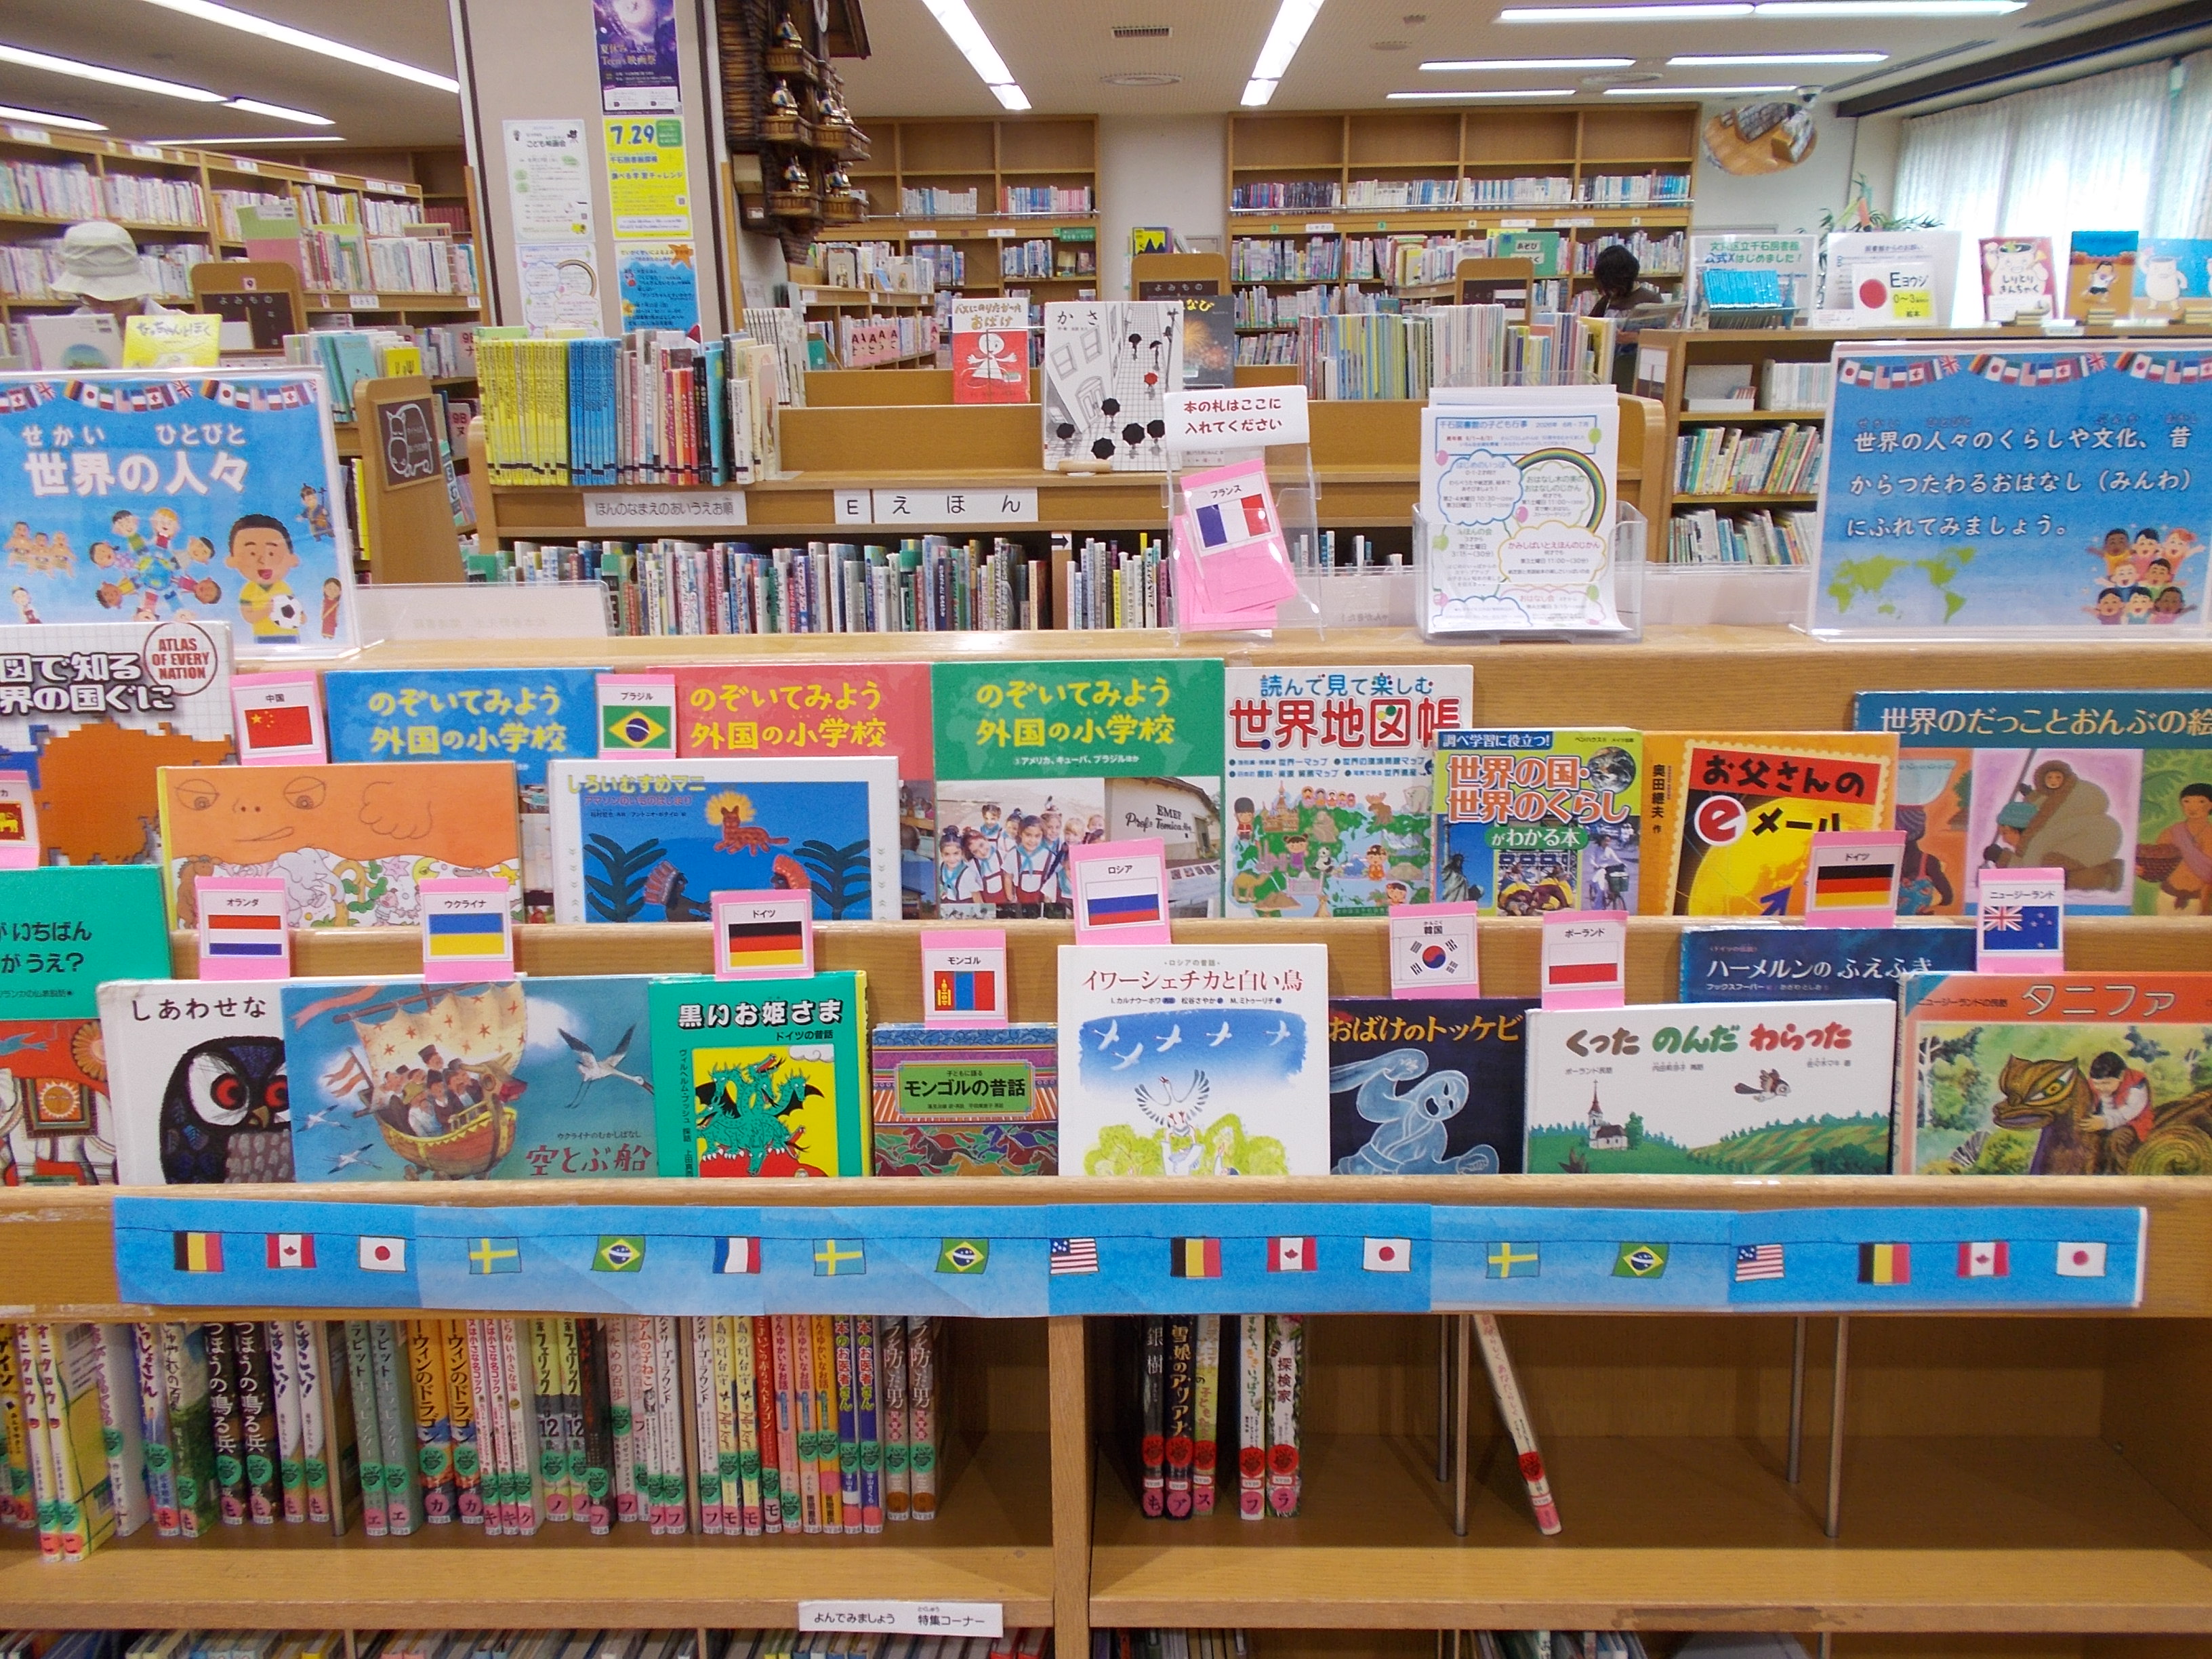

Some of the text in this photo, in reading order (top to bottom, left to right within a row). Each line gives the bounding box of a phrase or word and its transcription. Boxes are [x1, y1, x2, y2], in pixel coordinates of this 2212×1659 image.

[610, 125, 655, 144] 7.29
[1517, 242, 1538, 251] あそび
[1155, 283, 1203, 291] よみもの
[219, 295, 273, 306] よみもの
[971, 314, 1013, 331] おばけ
[1057, 310, 1098, 325] かさ
[1183, 398, 1282, 414] 本の札はここに
[22, 424, 247, 446] せかい ひとびと
[1185, 419, 1282, 434] 入れてください
[1855, 426, 2192, 453] 世界の人々のくらしや文化、昔
[24, 451, 249, 497] 世界の人々
[1850, 468, 2192, 495] からつたわるおはなし（みんわ）
[1210, 485, 1242, 499] フランス
[596, 500, 735, 517] ほんのなまえのあいうえお順
[847, 500, 859, 514] E
[893, 495, 1021, 514] えほん
[1846, 515, 2067, 537] にふれてみましょう。
[158, 638, 198, 651] ATLAS
[0, 653, 142, 682] 図で知る
[152, 652, 209, 667] OF EVERY
[159, 667, 206, 680] NATION
[975, 676, 1171, 709] のぞいてみよう
[1260, 672, 1434, 697] 読んで見て楽しむ
[0, 684, 175, 714] 界の国ぐに
[265, 693, 285, 703] 中国
[369, 686, 561, 717] のぞいてみよう
[620, 691, 653, 701] ブラジル
[690, 681, 882, 713] のぞいてみよう
[976, 713, 1176, 748] 外国の小学校
[1229, 697, 1461, 749] 世界地図帳
[1881, 707, 2212, 737] 世界のだっことおんぶの絵
[370, 722, 567, 755] 外国の小学校
[690, 718, 888, 750] 外国の小学校
[568, 774, 706, 795] しろいむすめマニ
[1702, 754, 1866, 798] お父さんの
[583, 796, 693, 807] アマゾンのいものはじまり
[1447, 788, 1631, 824] 世界のくらし
[1492, 829, 1581, 847] がわかる本
[1845, 852, 1870, 862] ドイツ
[1107, 864, 1133, 876] ロシア
[226, 898, 259, 907] オランダ
[1990, 889, 2056, 900] ニュージーランド
[444, 899, 487, 909] ウクライナ
[752, 909, 777, 919] ドイツ
[1424, 925, 1443, 935] 韓国
[1564, 928, 1605, 938] ポーランド
[947, 956, 981, 966] モンゴル
[1082, 968, 1303, 991] イワーシェチカと白い鳥
[132, 996, 266, 1021] しあわせな
[1181, 996, 1216, 1005] 松谷さやか
[2022, 983, 2176, 1017] タニファ
[678, 998, 844, 1030] 黒いお姫さま
[776, 1029, 834, 1042] ドイツの昔話
[1328, 1014, 1523, 1042] おばけのトッケビ
[1565, 1021, 1853, 1058] くった のんだ わらった
[946, 1069, 983, 1078] 子どもに語る
[904, 1078, 1026, 1098] モンゴルの昔話
[556, 1130, 641, 1139] ウクライナのむかしばなし
[526, 1143, 653, 1176] 空とぶ船
[1147, 1326, 1164, 1374] 銀樹
[1169, 1324, 1191, 1437] 雪娘のアリアナ
[814, 1612, 985, 1626] よんでみましょう 特集コーナー
